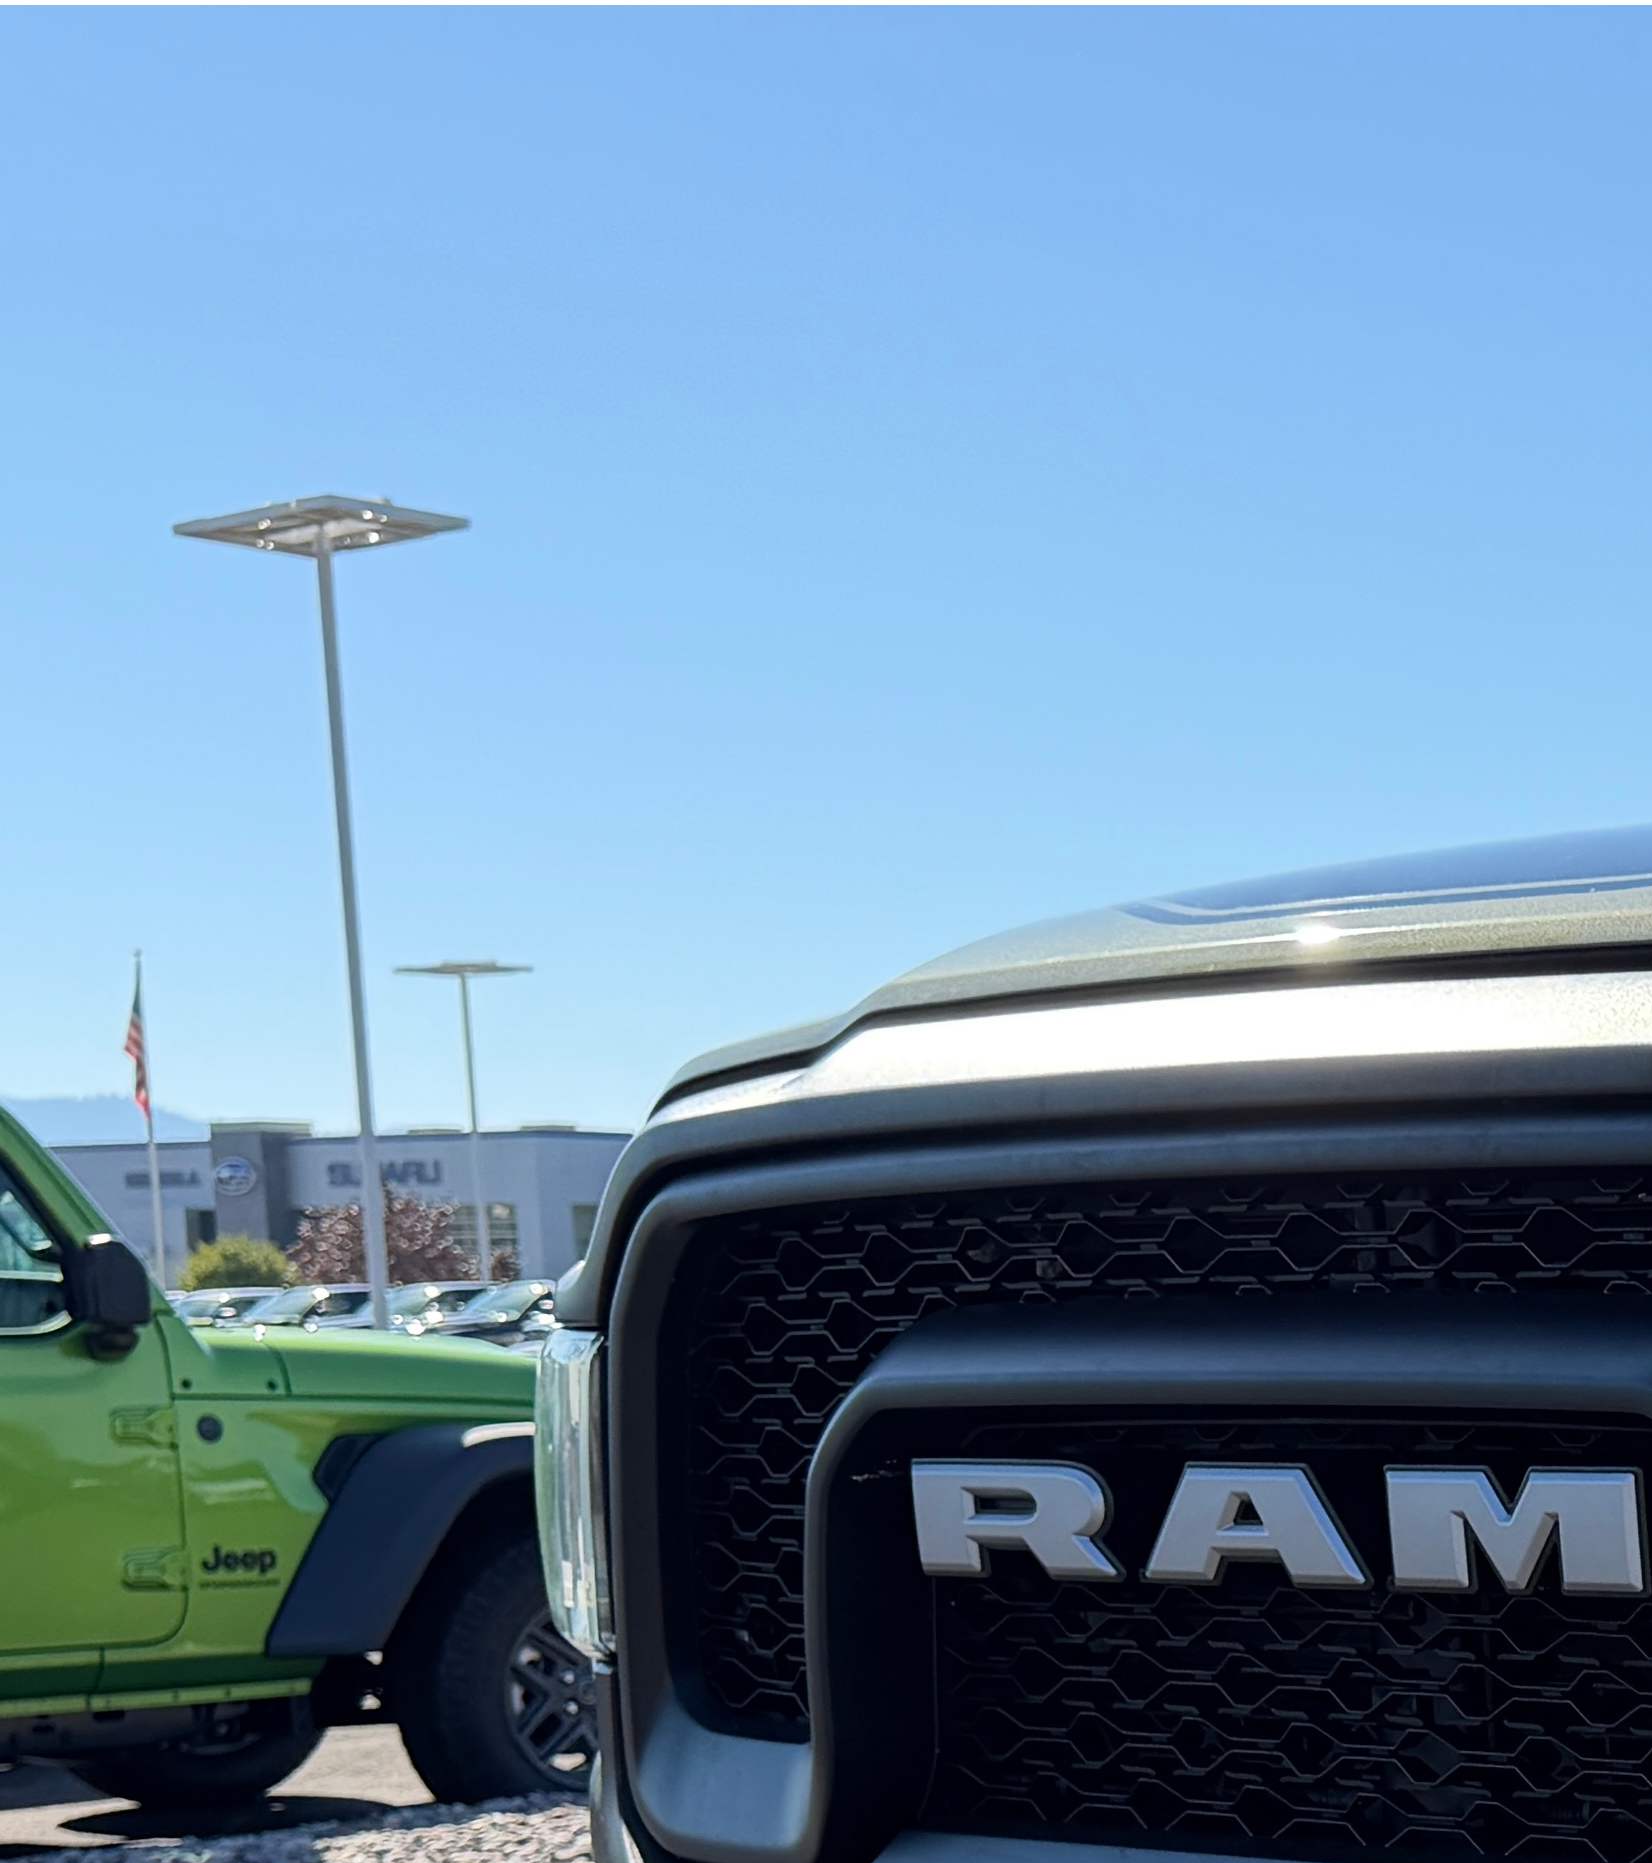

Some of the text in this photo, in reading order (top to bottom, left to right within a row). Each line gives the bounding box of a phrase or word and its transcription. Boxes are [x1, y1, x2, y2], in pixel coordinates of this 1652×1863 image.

[328, 1159, 442, 1187] SUARU
[911, 1458, 1652, 1597] RAM
[202, 1543, 278, 1575] Jeep
